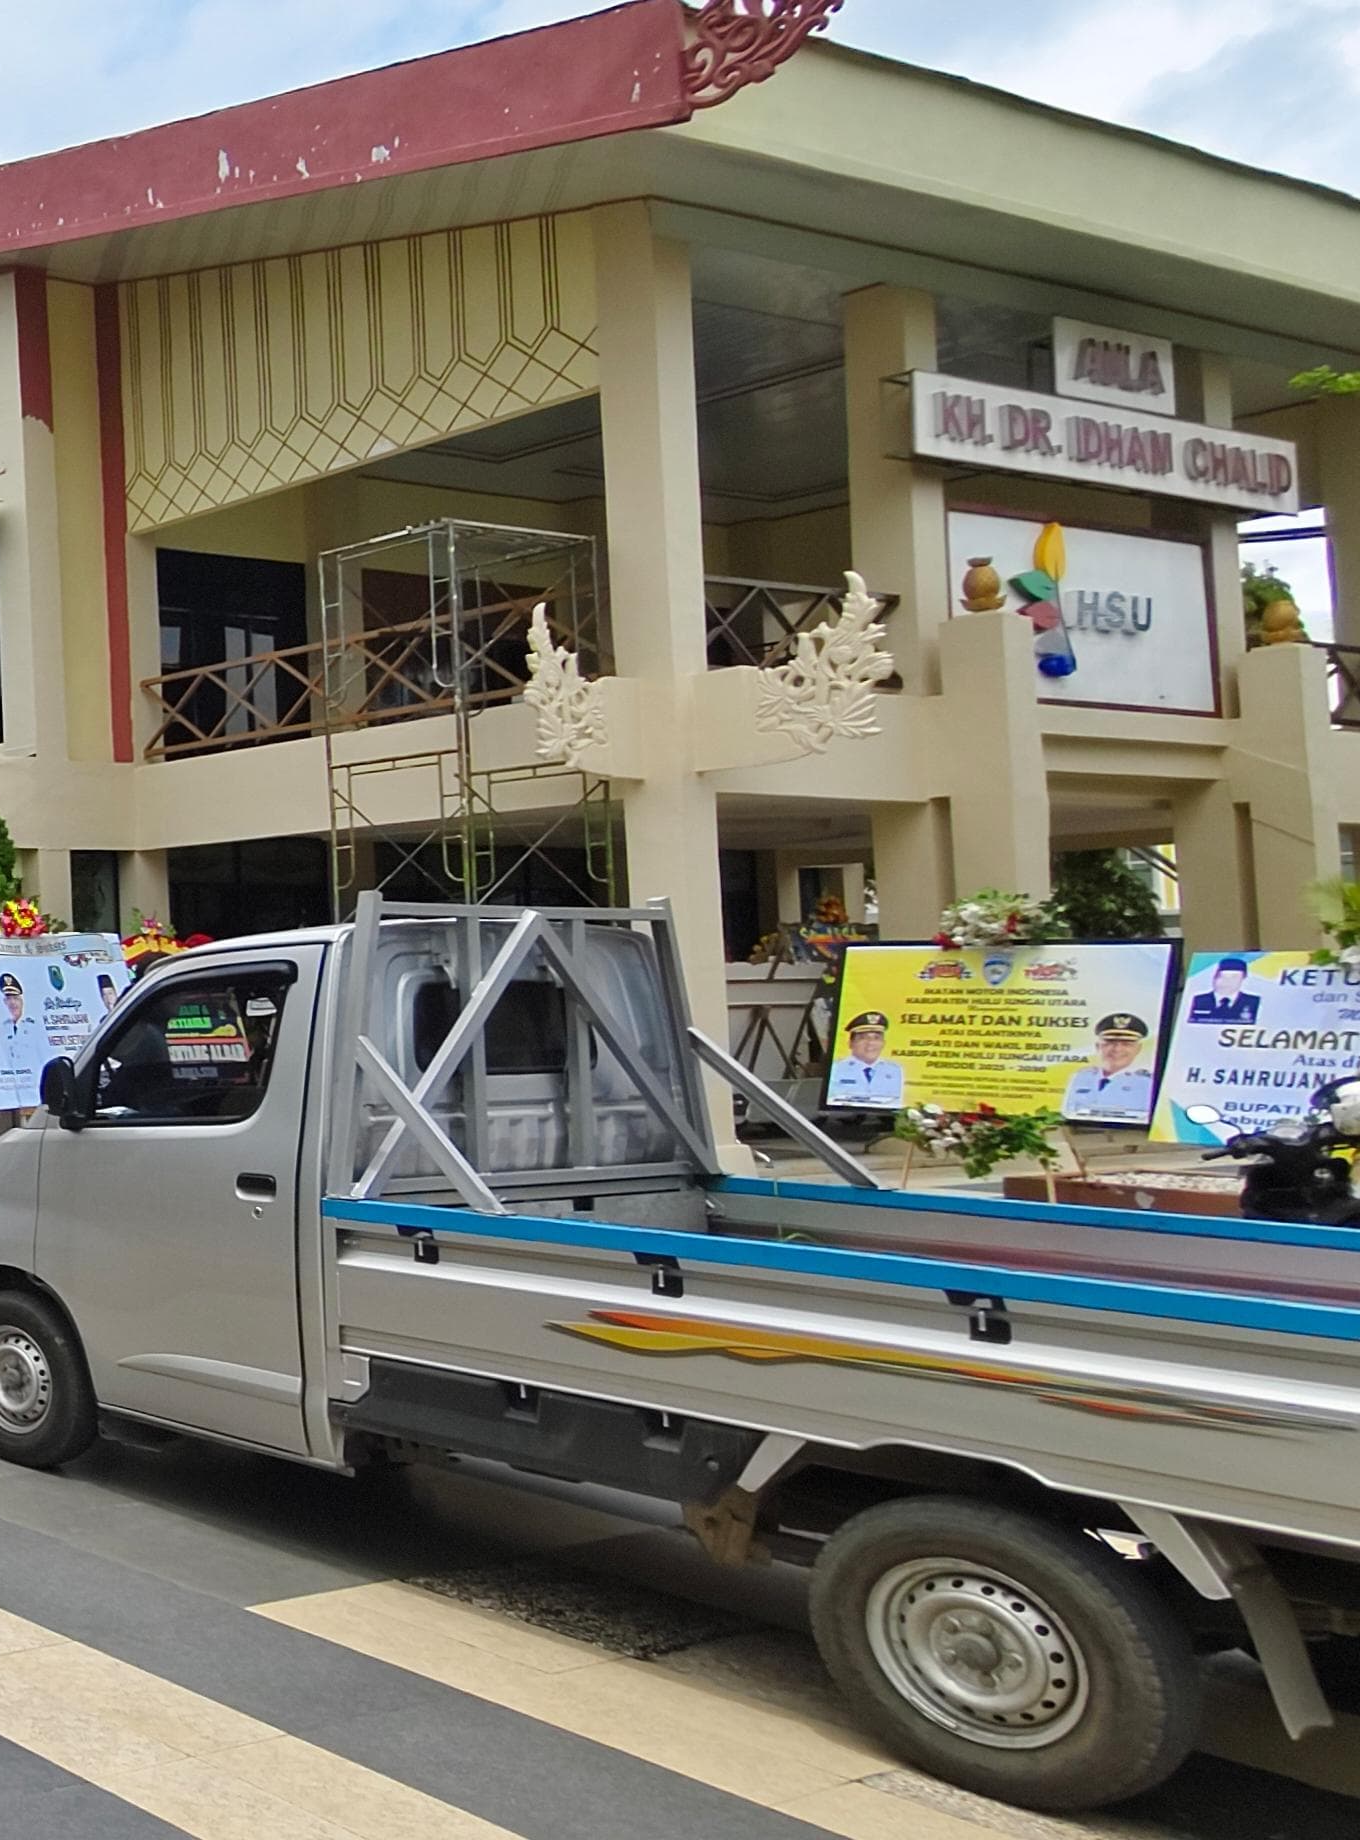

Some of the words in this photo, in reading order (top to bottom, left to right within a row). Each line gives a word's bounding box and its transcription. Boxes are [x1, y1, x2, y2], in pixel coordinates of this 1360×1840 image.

[932, 391, 994, 446] KH.
[998, 403, 1063, 457] DR.
[1183, 437, 1292, 497] CHALID
[924, 988, 964, 996] IKATAN
[1312, 991, 1349, 1004] dan
[905, 997, 970, 1006] KABUPATEN
[970, 998, 1003, 1006] HULU
[1003, 998, 1045, 1007] SUNGAI
[1046, 999, 1087, 1008] UTARA
[900, 1013, 977, 1026] SELAMAT
[980, 1015, 1023, 1027] DAN
[1027, 1016, 1090, 1029] SUKSES
[909, 1039, 953, 1048] BUPATI
[954, 1040, 981, 1049] DAN
[982, 1041, 1023, 1051] WAKIL
[1024, 1042, 1071, 1052] BUPATI
[1217, 1028, 1360, 1051] SELAMAT
[890, 1049, 961, 1060] KABUPATEN
[1046, 1054, 1090, 1064] UTARA
[1292, 1053, 1337, 1068] Atas
[925, 1061, 976, 1071] PERIODE
[1186, 1067, 1208, 1084] H.
[1223, 1100, 1303, 1116] BUPATI
